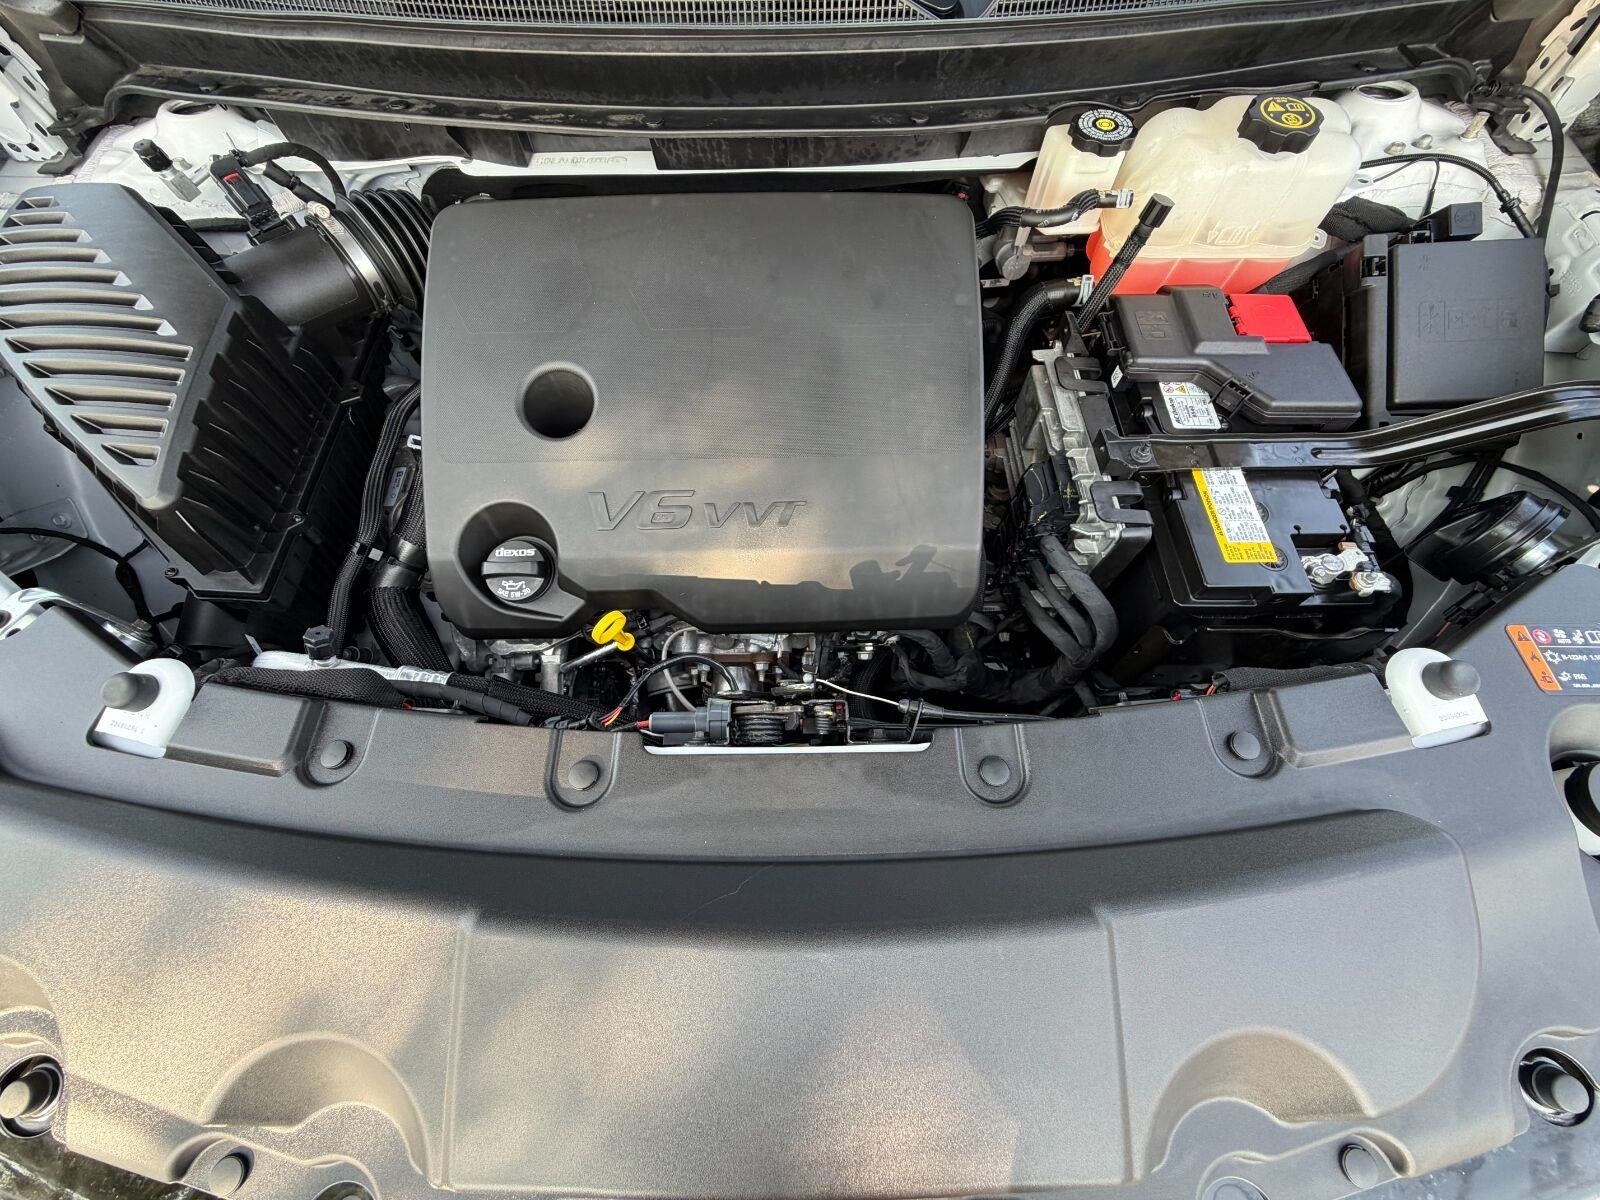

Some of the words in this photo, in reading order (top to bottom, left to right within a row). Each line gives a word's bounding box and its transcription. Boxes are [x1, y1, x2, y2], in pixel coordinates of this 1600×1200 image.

[587, 489, 696, 532] V6
[703, 500, 808, 529] VVT
[495, 547, 537, 557] dexos
